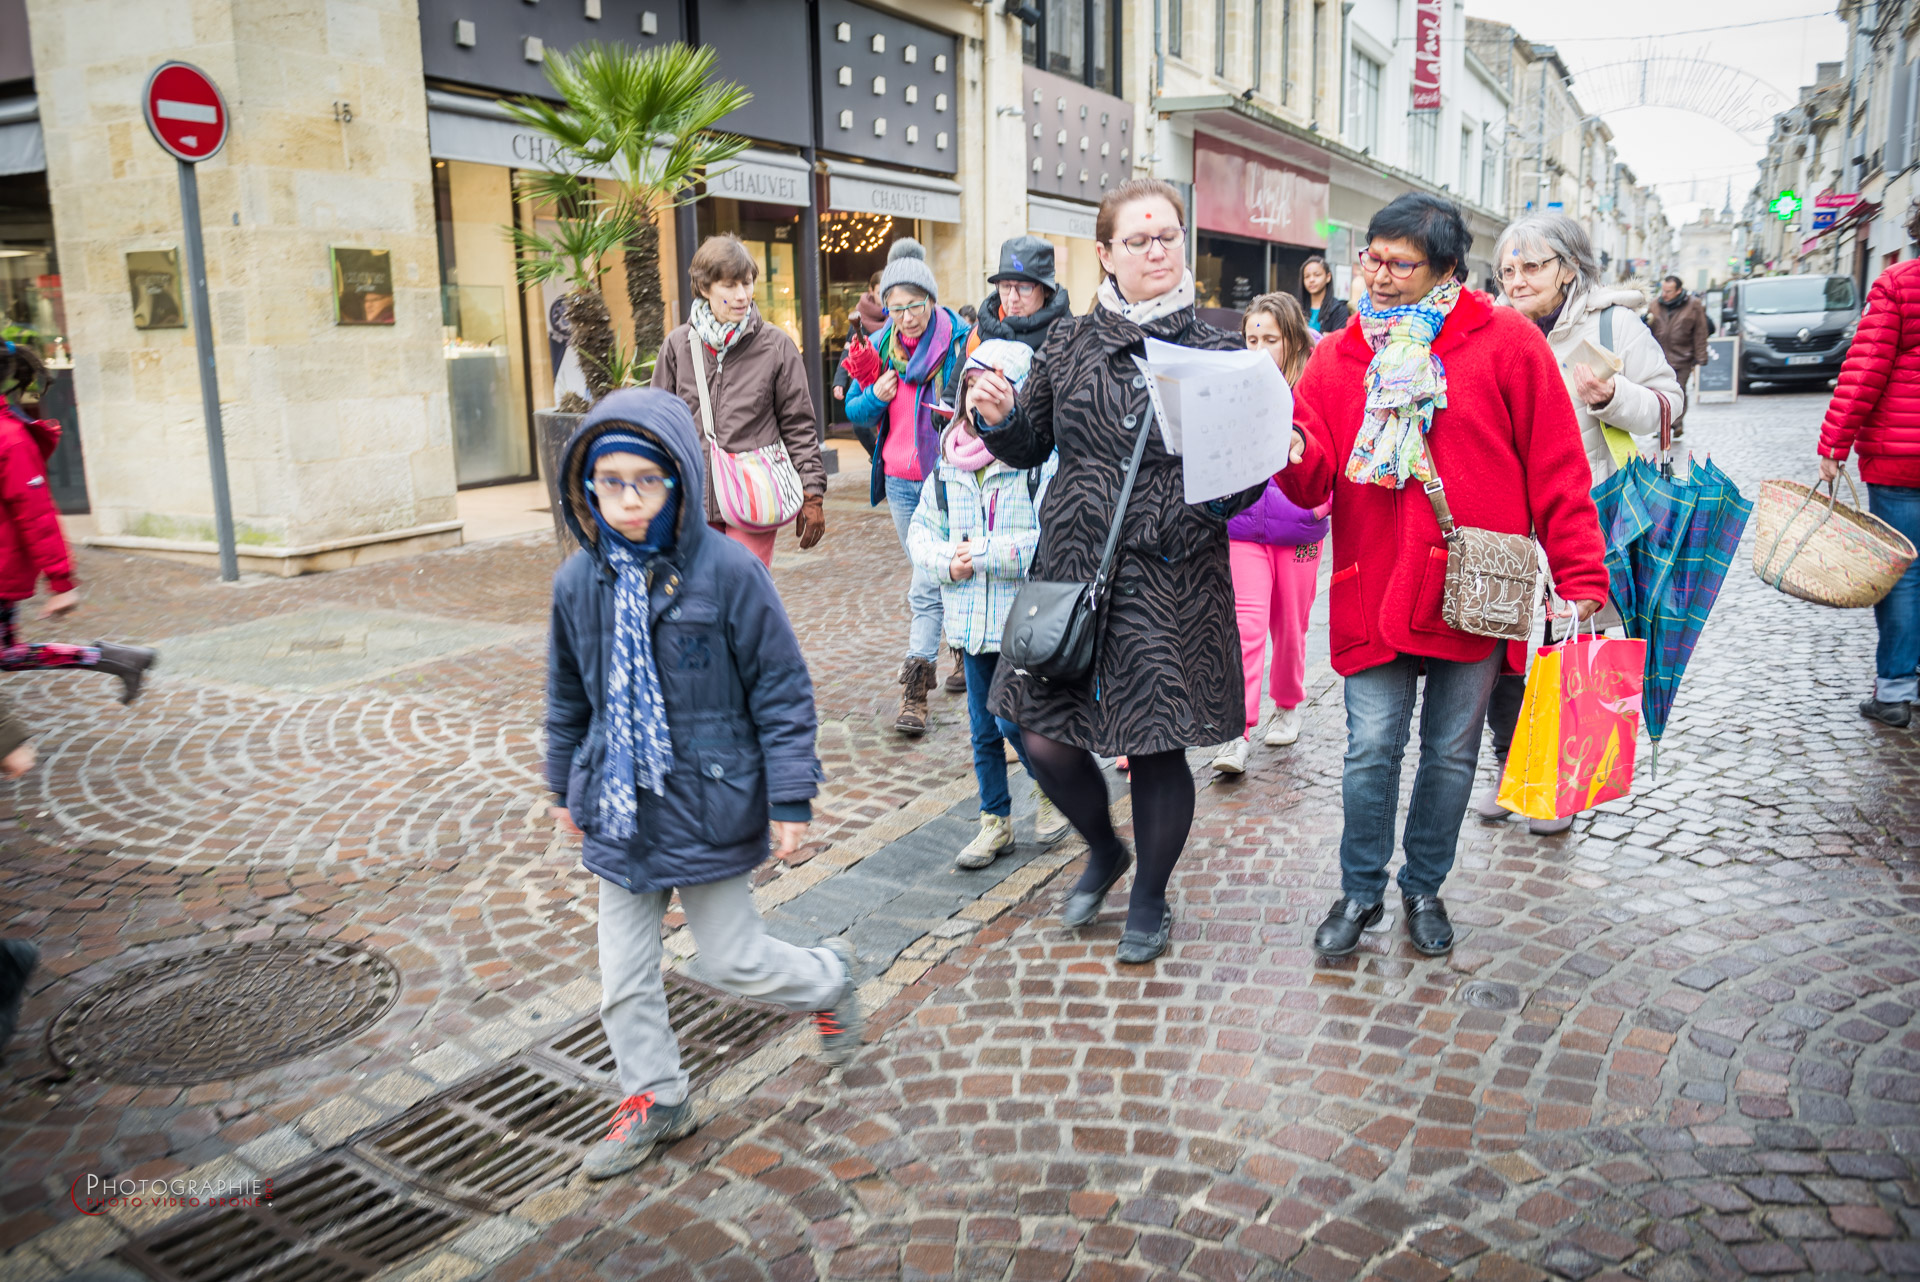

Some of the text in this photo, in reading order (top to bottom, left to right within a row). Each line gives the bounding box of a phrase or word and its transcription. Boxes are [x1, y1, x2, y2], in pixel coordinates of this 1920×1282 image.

[333, 101, 353, 123] 15
[722, 171, 797, 199] CHAUVET
[871, 188, 927, 214] CHAUVET
